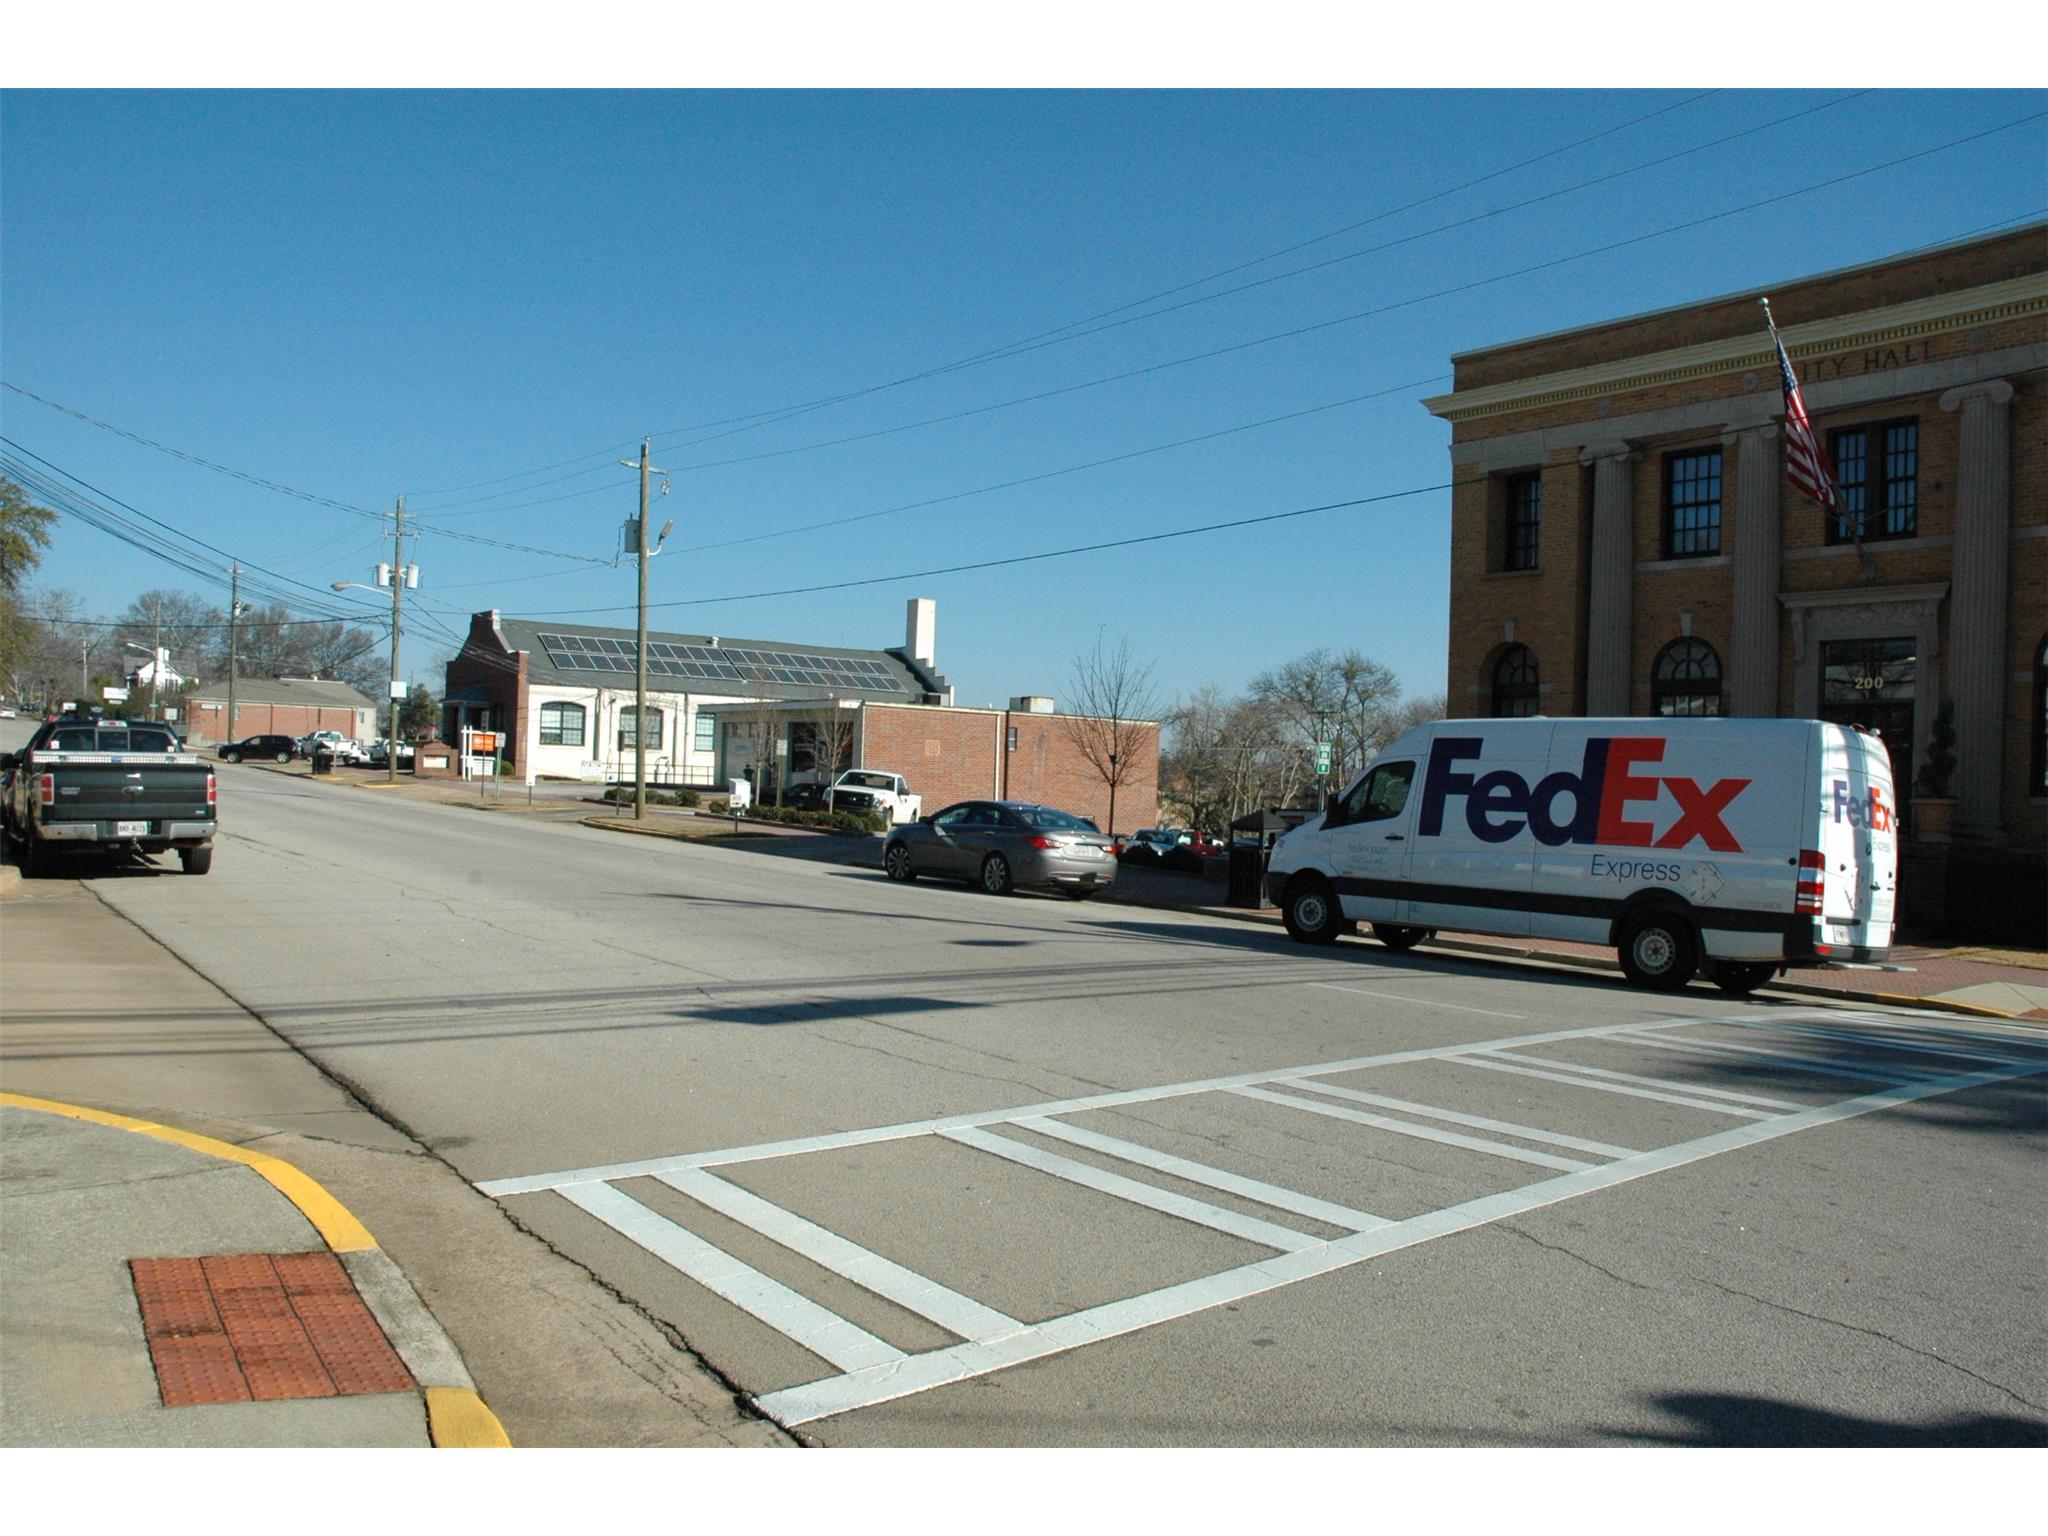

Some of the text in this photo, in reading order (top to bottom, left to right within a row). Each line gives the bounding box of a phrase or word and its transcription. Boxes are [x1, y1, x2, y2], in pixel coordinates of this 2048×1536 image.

[1796, 341, 1937, 382] ITY HALL
[1855, 677, 1884, 689] 200
[1418, 737, 1752, 854] FedEx
[1833, 779, 1892, 834] FedEx
[1591, 854, 1681, 883] Express
